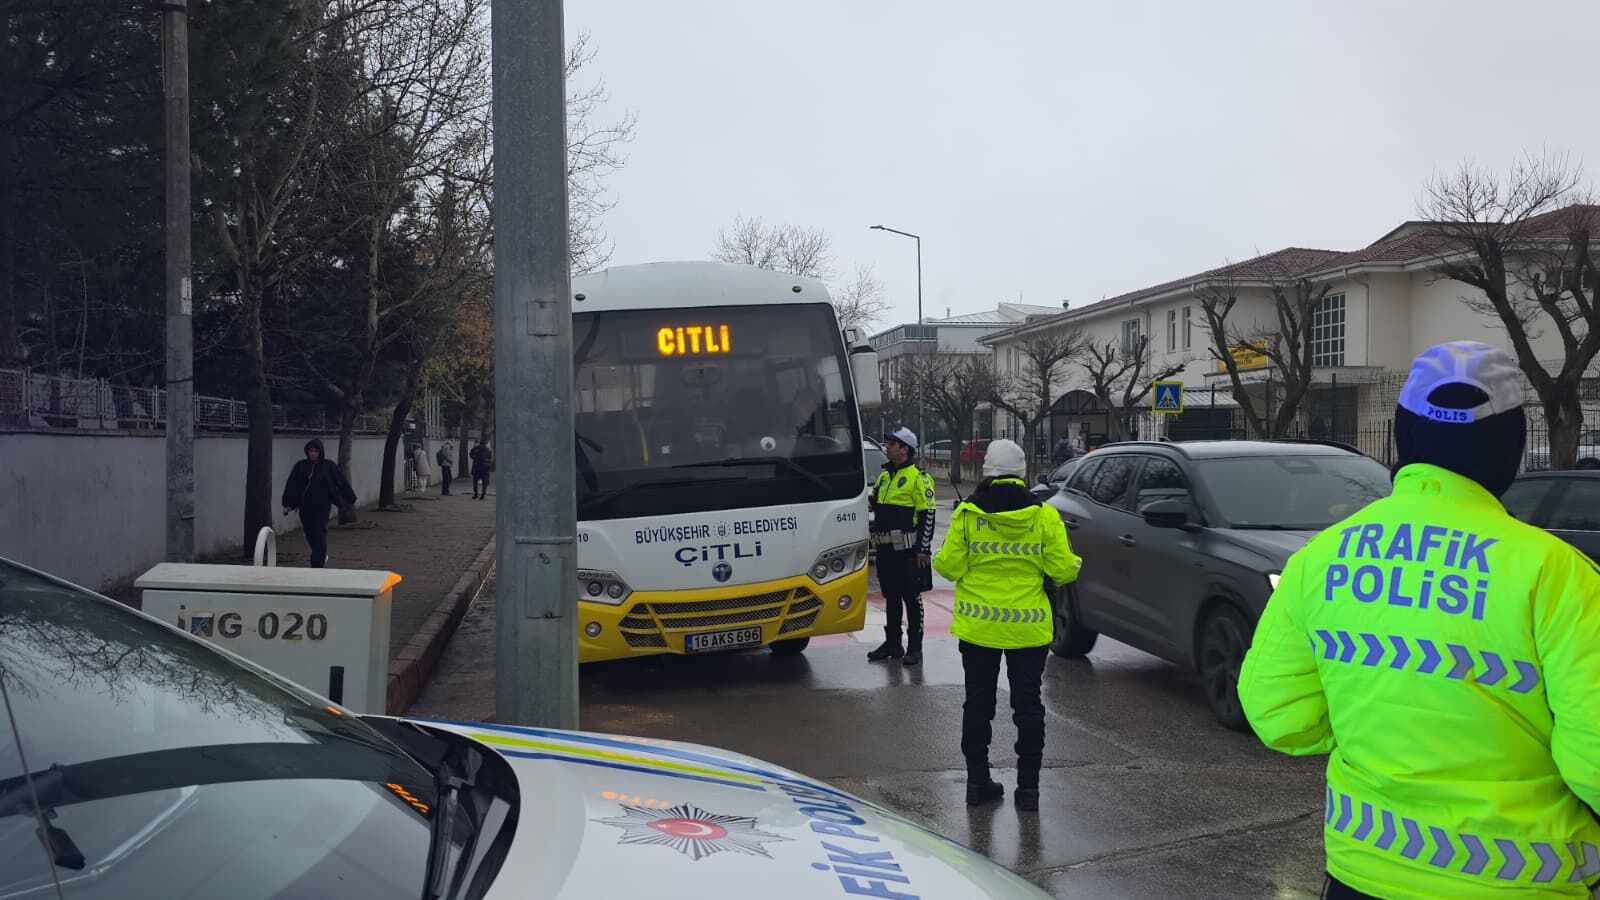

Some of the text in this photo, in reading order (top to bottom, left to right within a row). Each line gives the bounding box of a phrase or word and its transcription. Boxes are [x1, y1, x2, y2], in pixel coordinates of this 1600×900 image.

[836, 512, 857, 522] 6410
[258, 612, 328, 641] 020
[694, 629, 760, 649] 16 AKS 696
